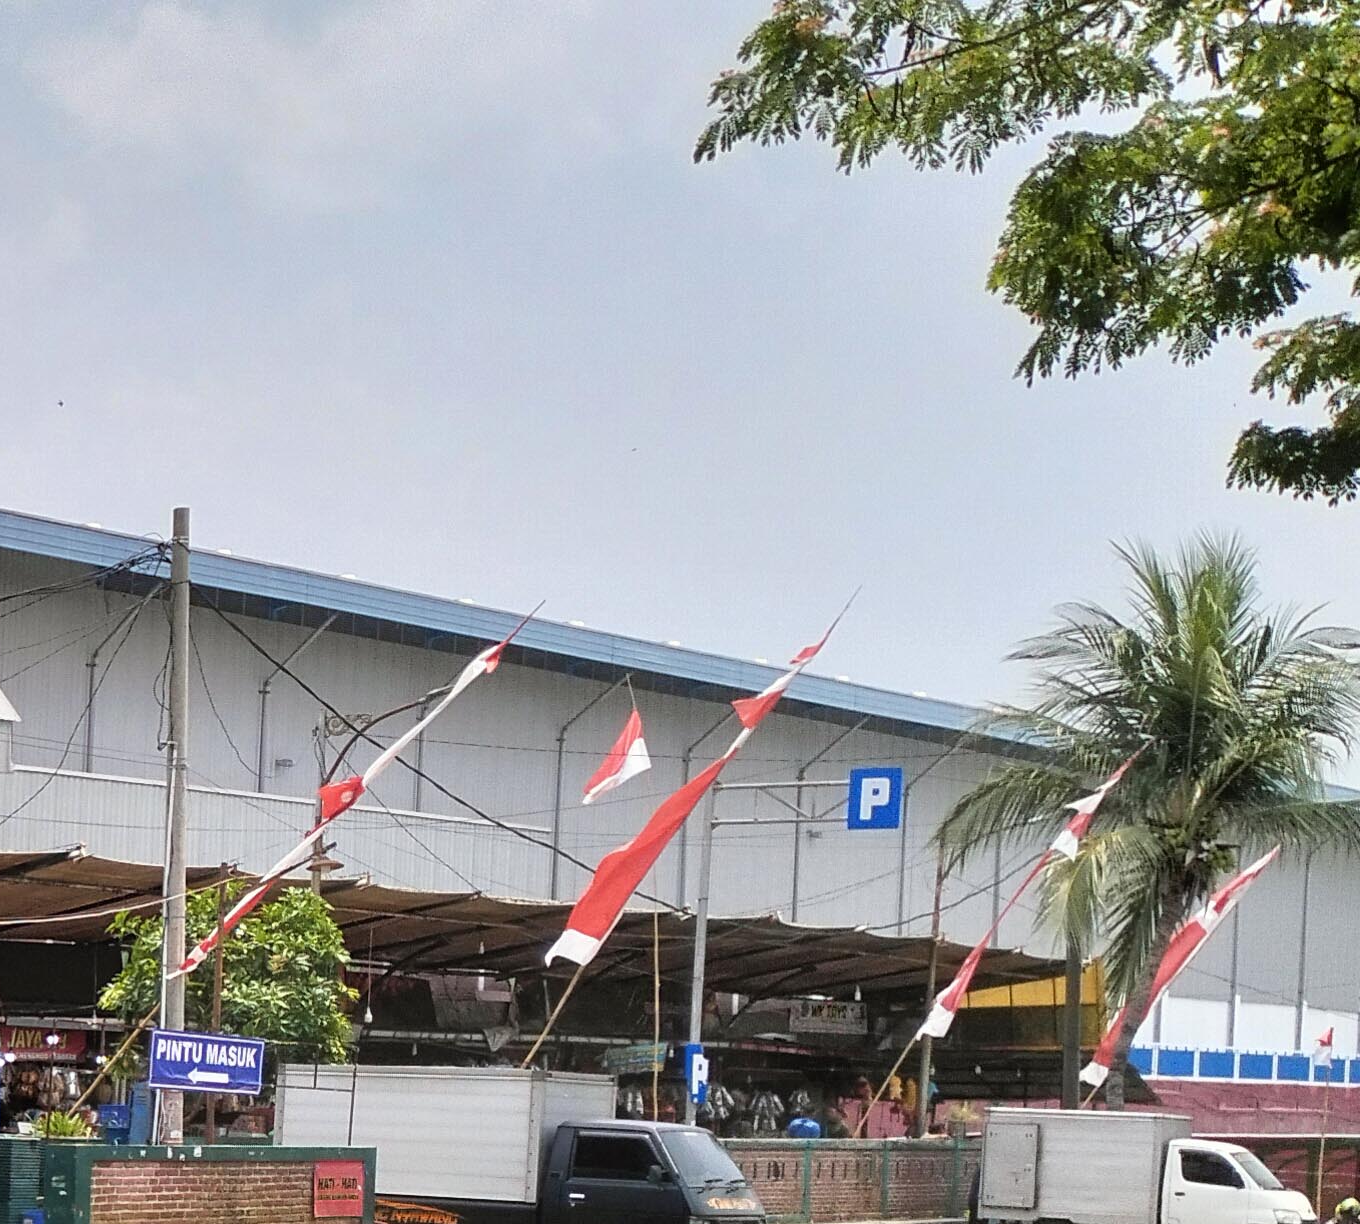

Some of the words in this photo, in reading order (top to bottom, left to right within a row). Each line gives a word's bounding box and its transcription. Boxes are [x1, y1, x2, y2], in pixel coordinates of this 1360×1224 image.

[859, 777, 890, 820] P
[7, 1027, 43, 1049] JAYA
[156, 1039, 203, 1063] PINTU
[206, 1043, 258, 1068] MASUK
